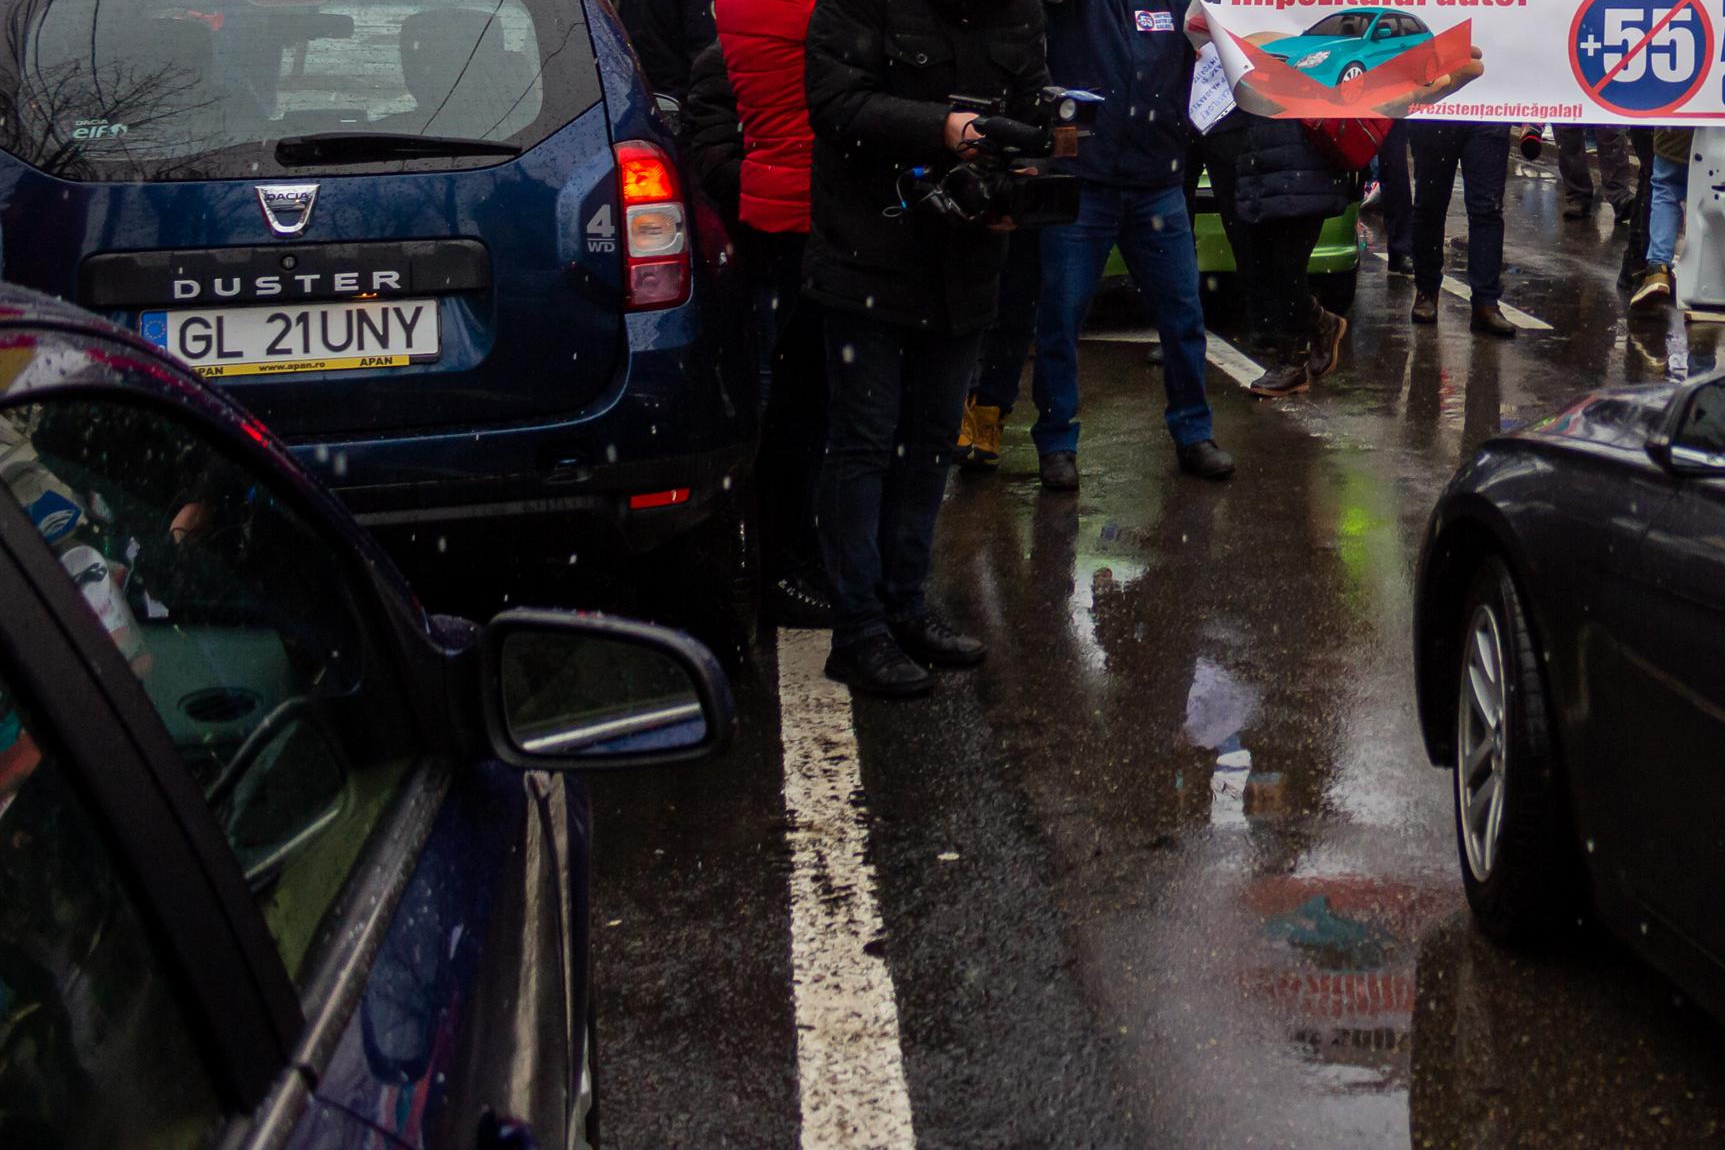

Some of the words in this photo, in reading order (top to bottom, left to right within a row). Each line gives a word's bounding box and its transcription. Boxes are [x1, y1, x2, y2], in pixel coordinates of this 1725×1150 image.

[73, 125, 109, 139] elf
[264, 192, 309, 201] DACIA
[587, 204, 615, 237] 4
[588, 241, 616, 252] WD
[173, 271, 401, 299] DUSTER
[179, 315, 244, 359] GL
[265, 306, 424, 356] 21UNY
[258, 361, 325, 372] www.apan.ro
[359, 357, 393, 367] APAN
